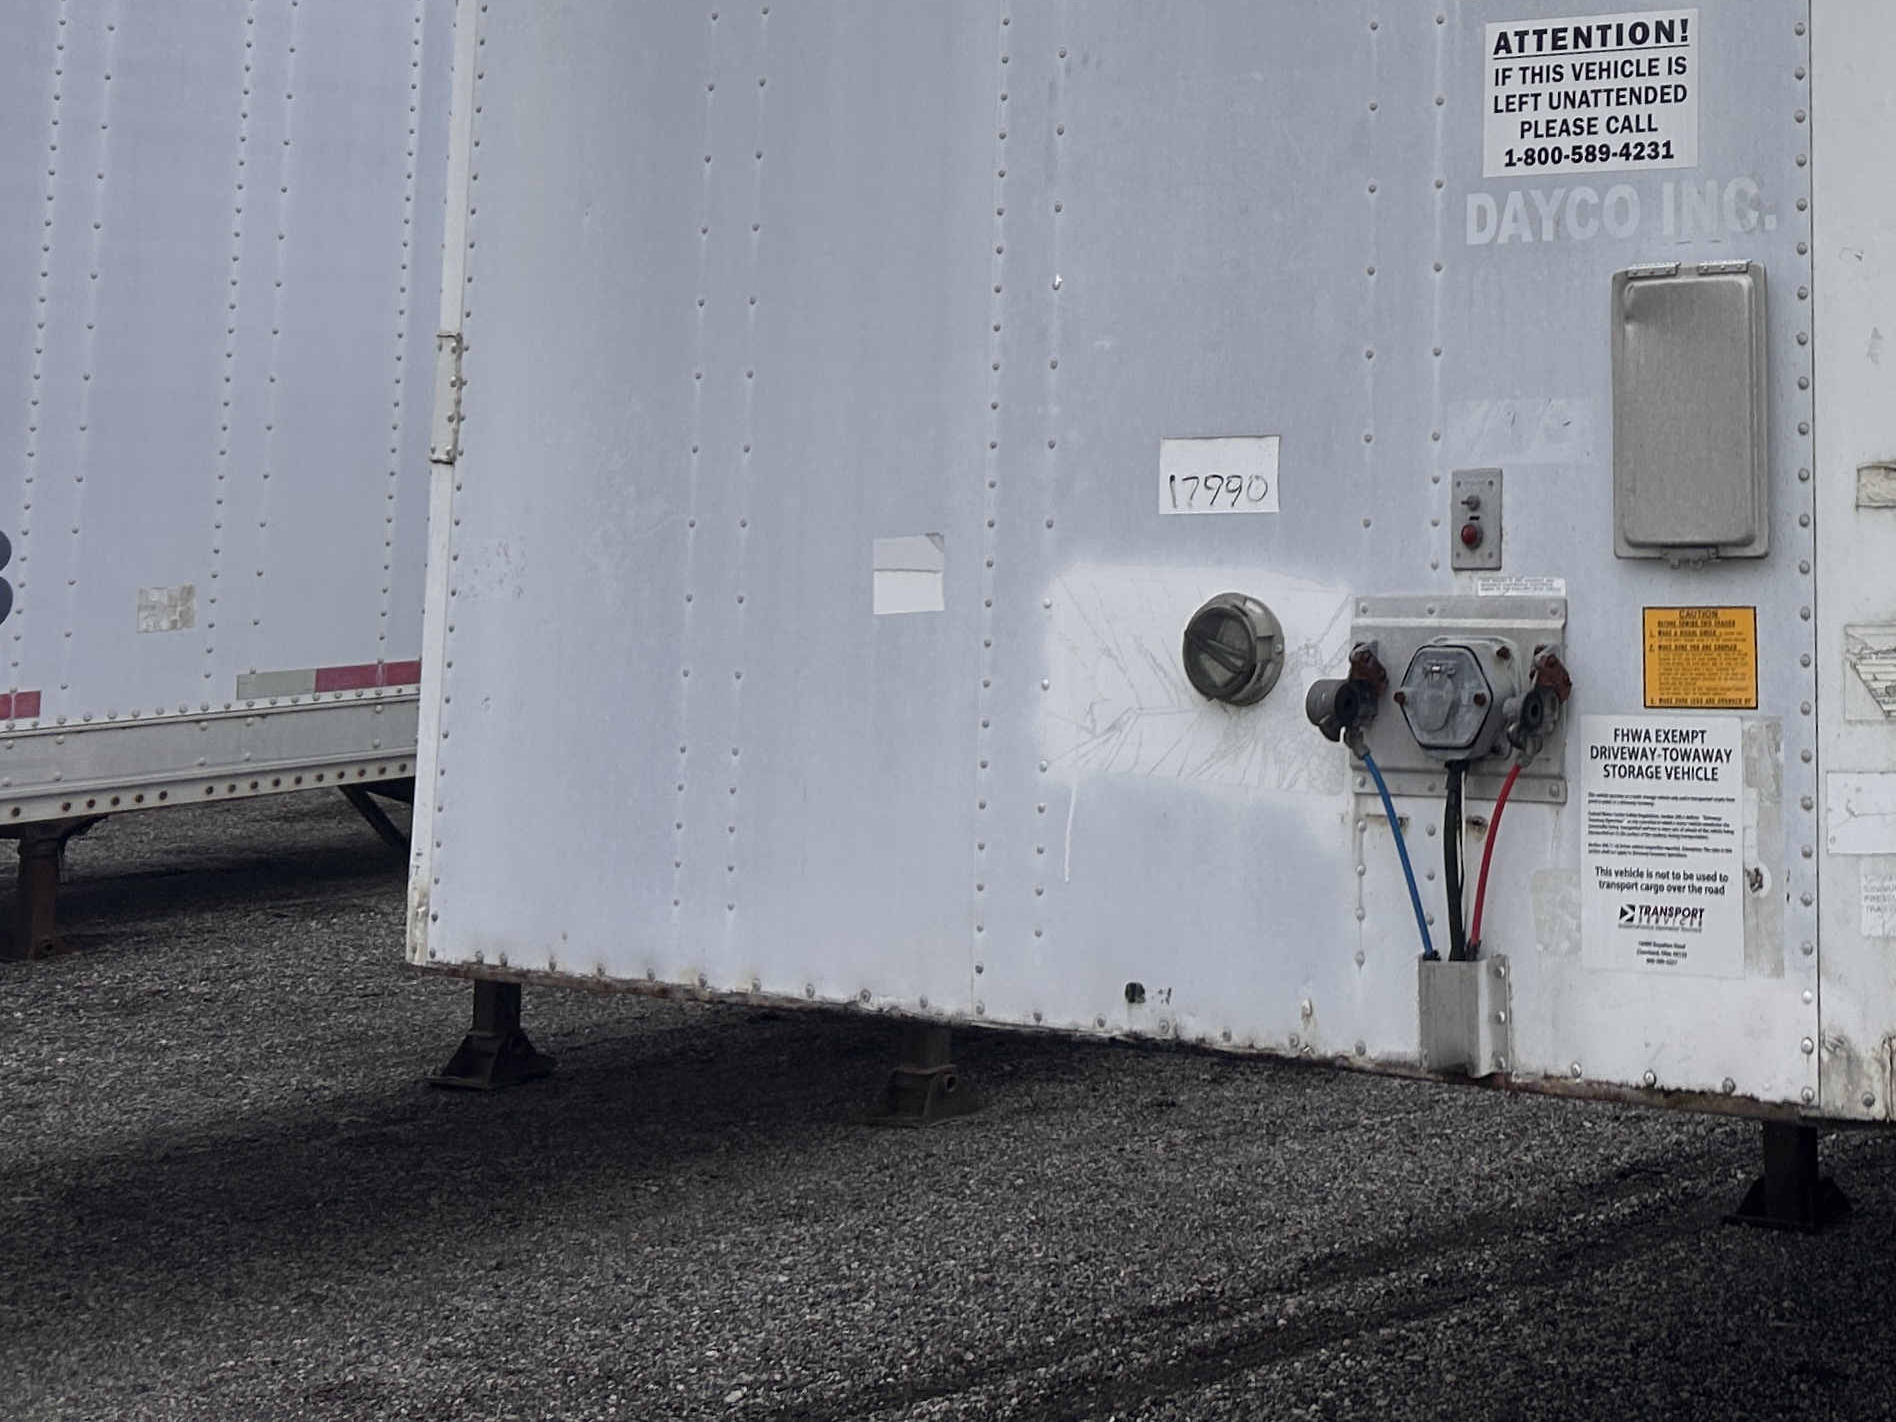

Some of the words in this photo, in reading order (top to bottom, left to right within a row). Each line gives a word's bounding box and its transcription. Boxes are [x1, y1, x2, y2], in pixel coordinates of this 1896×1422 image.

[1492, 17, 1690, 56] ATTENTION!
[1494, 67, 1513, 87] IF
[1518, 64, 1565, 85] THIS
[1571, 57, 1661, 82] VEHICLE
[1667, 55, 1688, 76] IS
[1493, 92, 1542, 114] LEFT
[1548, 84, 1688, 111] UNATTENDED
[1519, 116, 1599, 139] PLEASE
[1605, 113, 1659, 135] CALL
[1503, 140, 1674, 168] 1-800-589-4231
[1465, 183, 1641, 246] DAYCO
[1662, 177, 1778, 236] INC.
[1168, 474, 1269, 509] 17990
[1678, 609, 1719, 619] CAUTION
[1613, 727, 1652, 743] FHWA
[1655, 728, 1707, 745] EXEMPT
[1590, 744, 1733, 764] DRIVEWAY-TOWAWAY
[1603, 763, 1662, 780] STORAGE
[1664, 765, 1719, 782] VEHICLE
[1594, 866, 1613, 878] This
[1614, 866, 1645, 879] vehicle
[1646, 867, 1654, 879] is
[1655, 869, 1670, 880] not
[1671, 871, 1682, 880] to
[1683, 869, 1695, 881] be
[1696, 870, 1718, 882] used
[1719, 872, 1729, 883] to
[1598, 879, 1639, 893] transport
[1640, 884, 1665, 895] cargo
[1666, 884, 1687, 893] over
[1688, 883, 1703, 894] the
[1704, 884, 1726, 896] road
[1638, 904, 1706, 919] TRANSPORT
